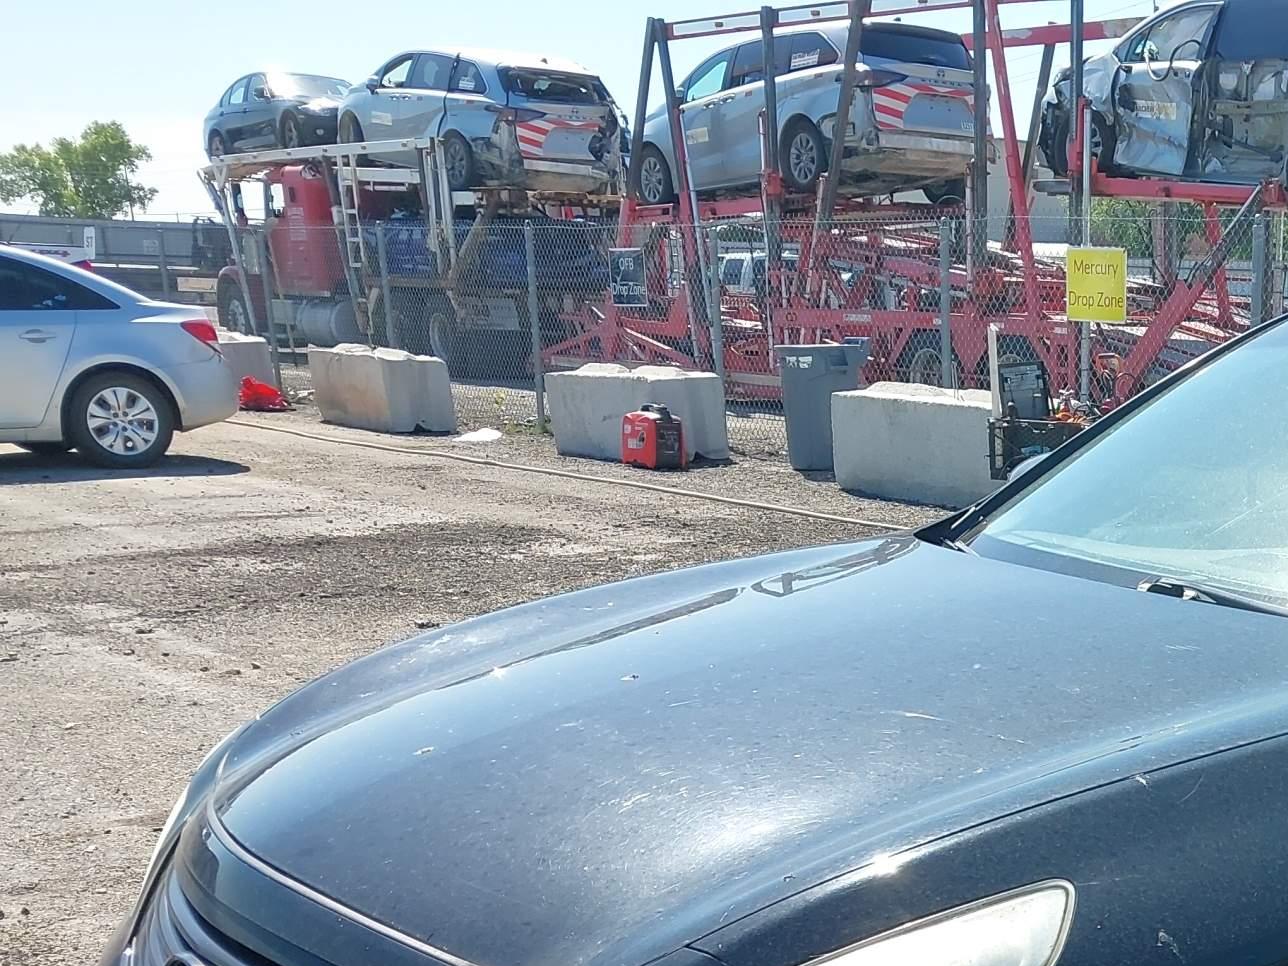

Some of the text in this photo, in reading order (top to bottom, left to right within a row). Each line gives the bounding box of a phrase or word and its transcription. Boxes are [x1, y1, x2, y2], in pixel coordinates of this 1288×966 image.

[1073, 259, 1119, 279] Mercury
[612, 282, 646, 298] Drop Zone
[1068, 290, 1124, 310] Drop Zone
